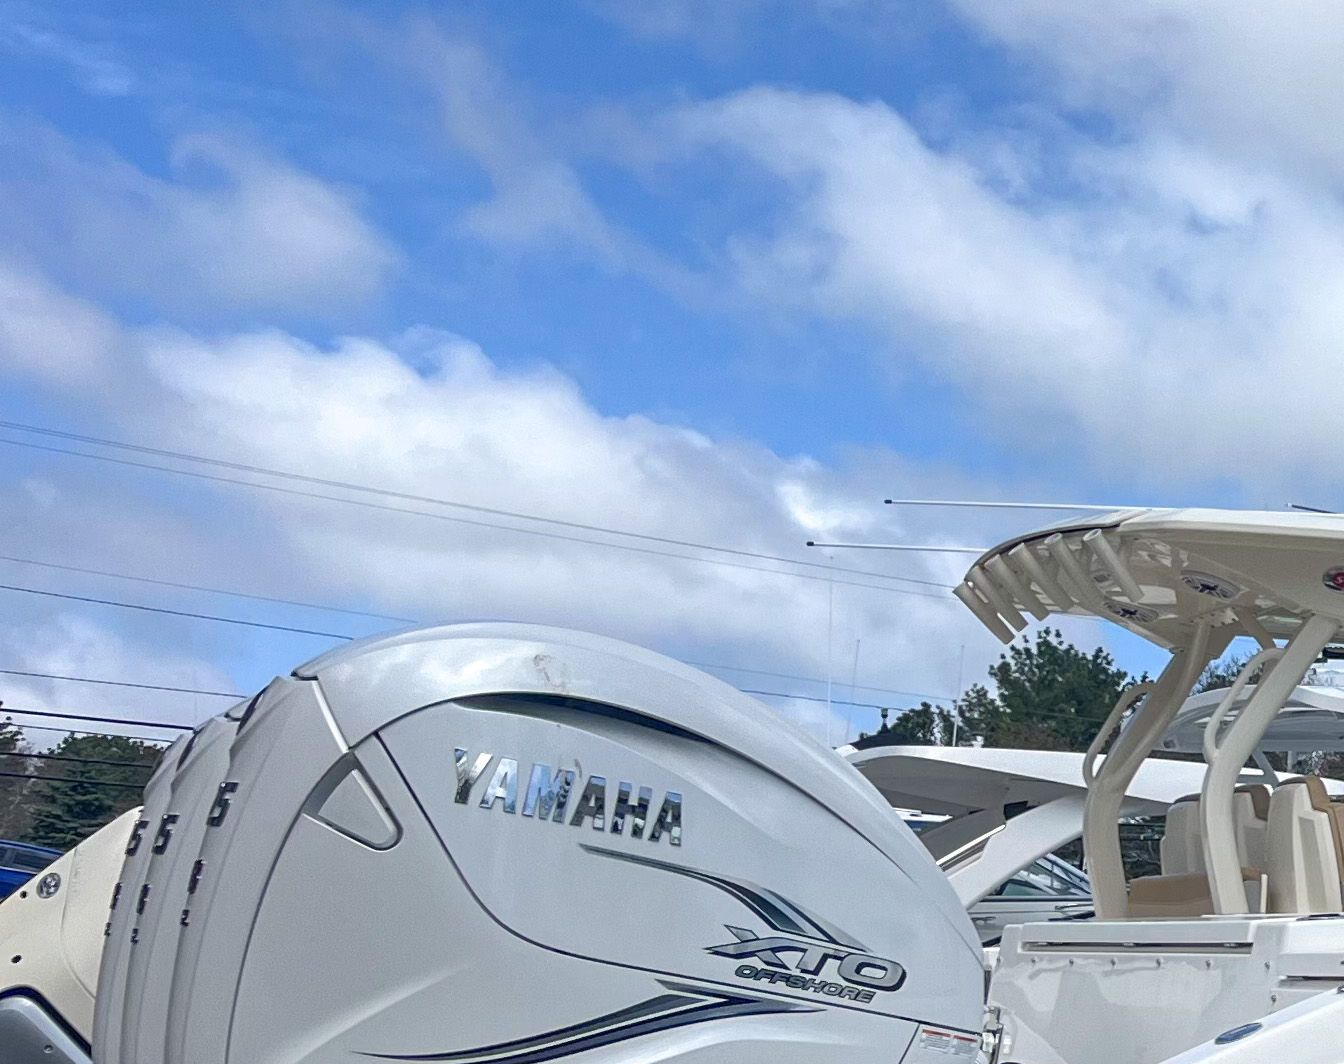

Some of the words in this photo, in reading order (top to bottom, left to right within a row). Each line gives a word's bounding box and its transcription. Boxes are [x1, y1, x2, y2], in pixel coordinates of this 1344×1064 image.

[453, 747, 682, 847] YAMAHA
[702, 924, 907, 992] XTO
[734, 964, 876, 1004] OFFSHORE
